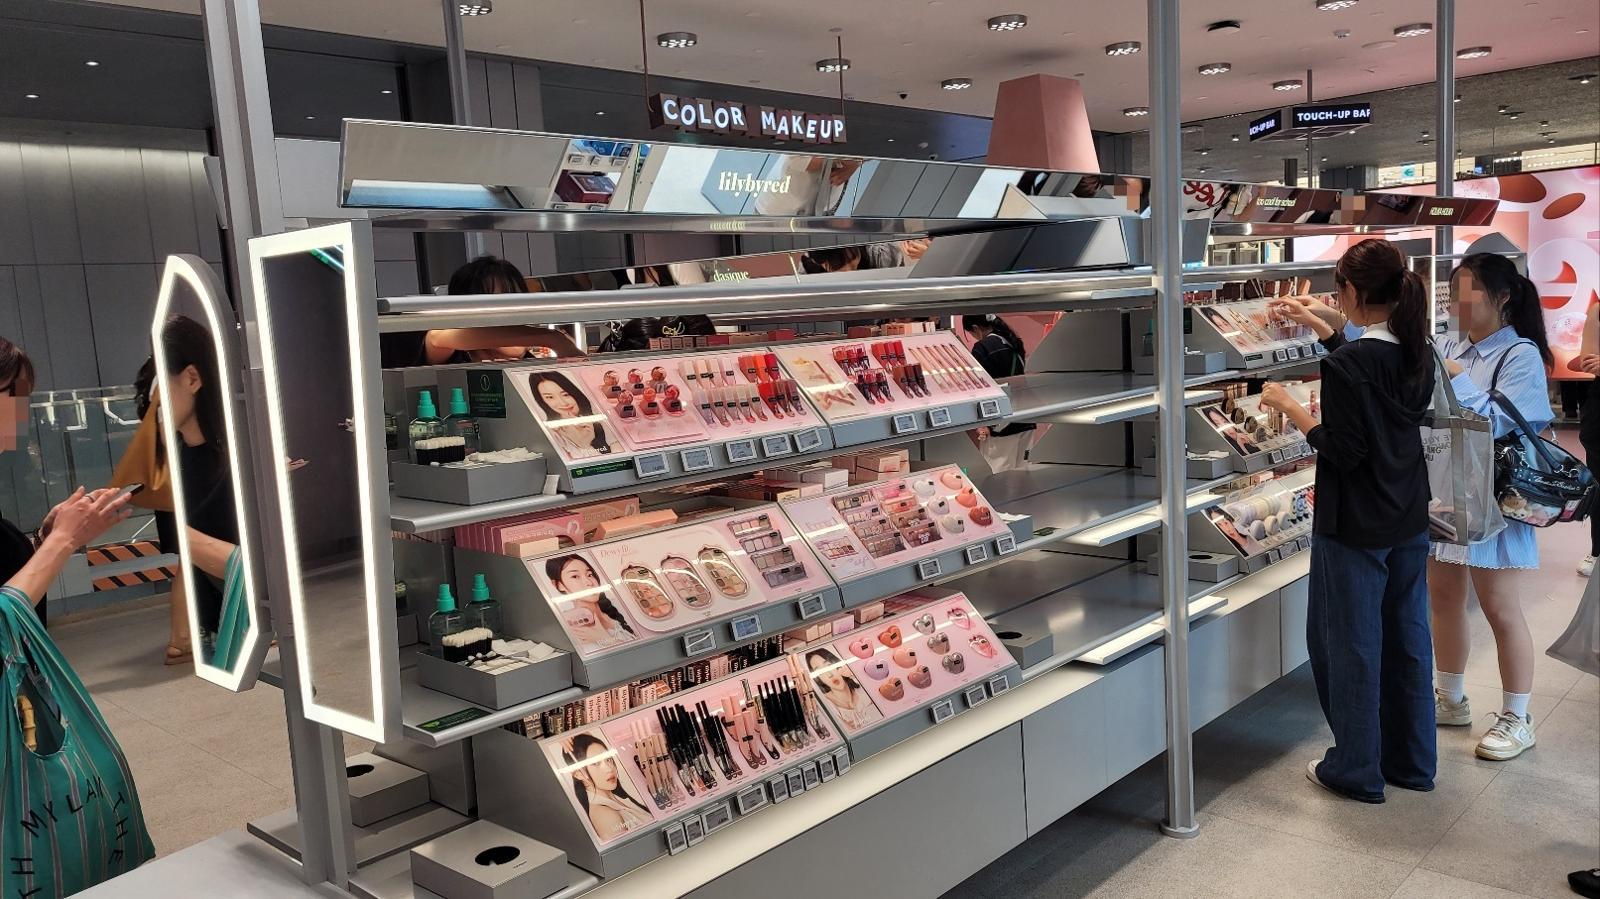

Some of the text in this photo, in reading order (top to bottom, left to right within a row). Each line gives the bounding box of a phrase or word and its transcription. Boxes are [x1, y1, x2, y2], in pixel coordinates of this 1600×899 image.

[663, 99, 844, 138] COLOR MAKEUP
[1297, 110, 1350, 122] TOUCH-UP
[718, 171, 791, 198] lilybyred
[713, 268, 749, 283] dasique
[109, 792, 129, 865] THE
